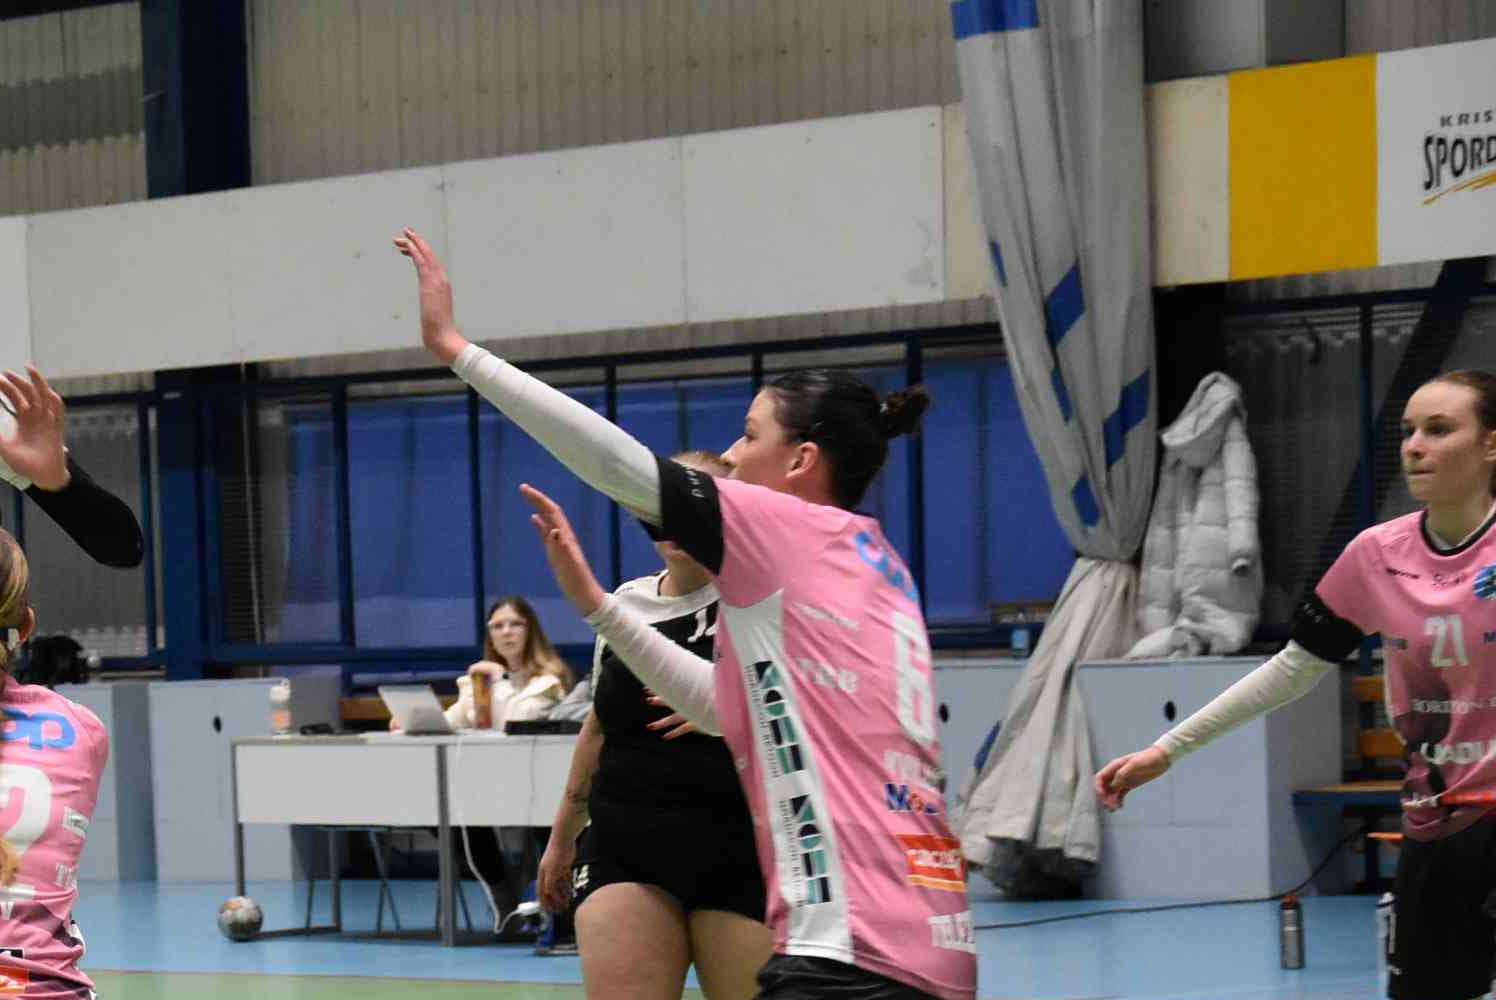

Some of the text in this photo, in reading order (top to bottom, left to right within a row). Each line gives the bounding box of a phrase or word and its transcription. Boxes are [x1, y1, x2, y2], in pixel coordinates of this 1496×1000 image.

[1440, 110, 1494, 128] KRIS
[1424, 614, 1469, 668] 21
[892, 609, 935, 745] 6
